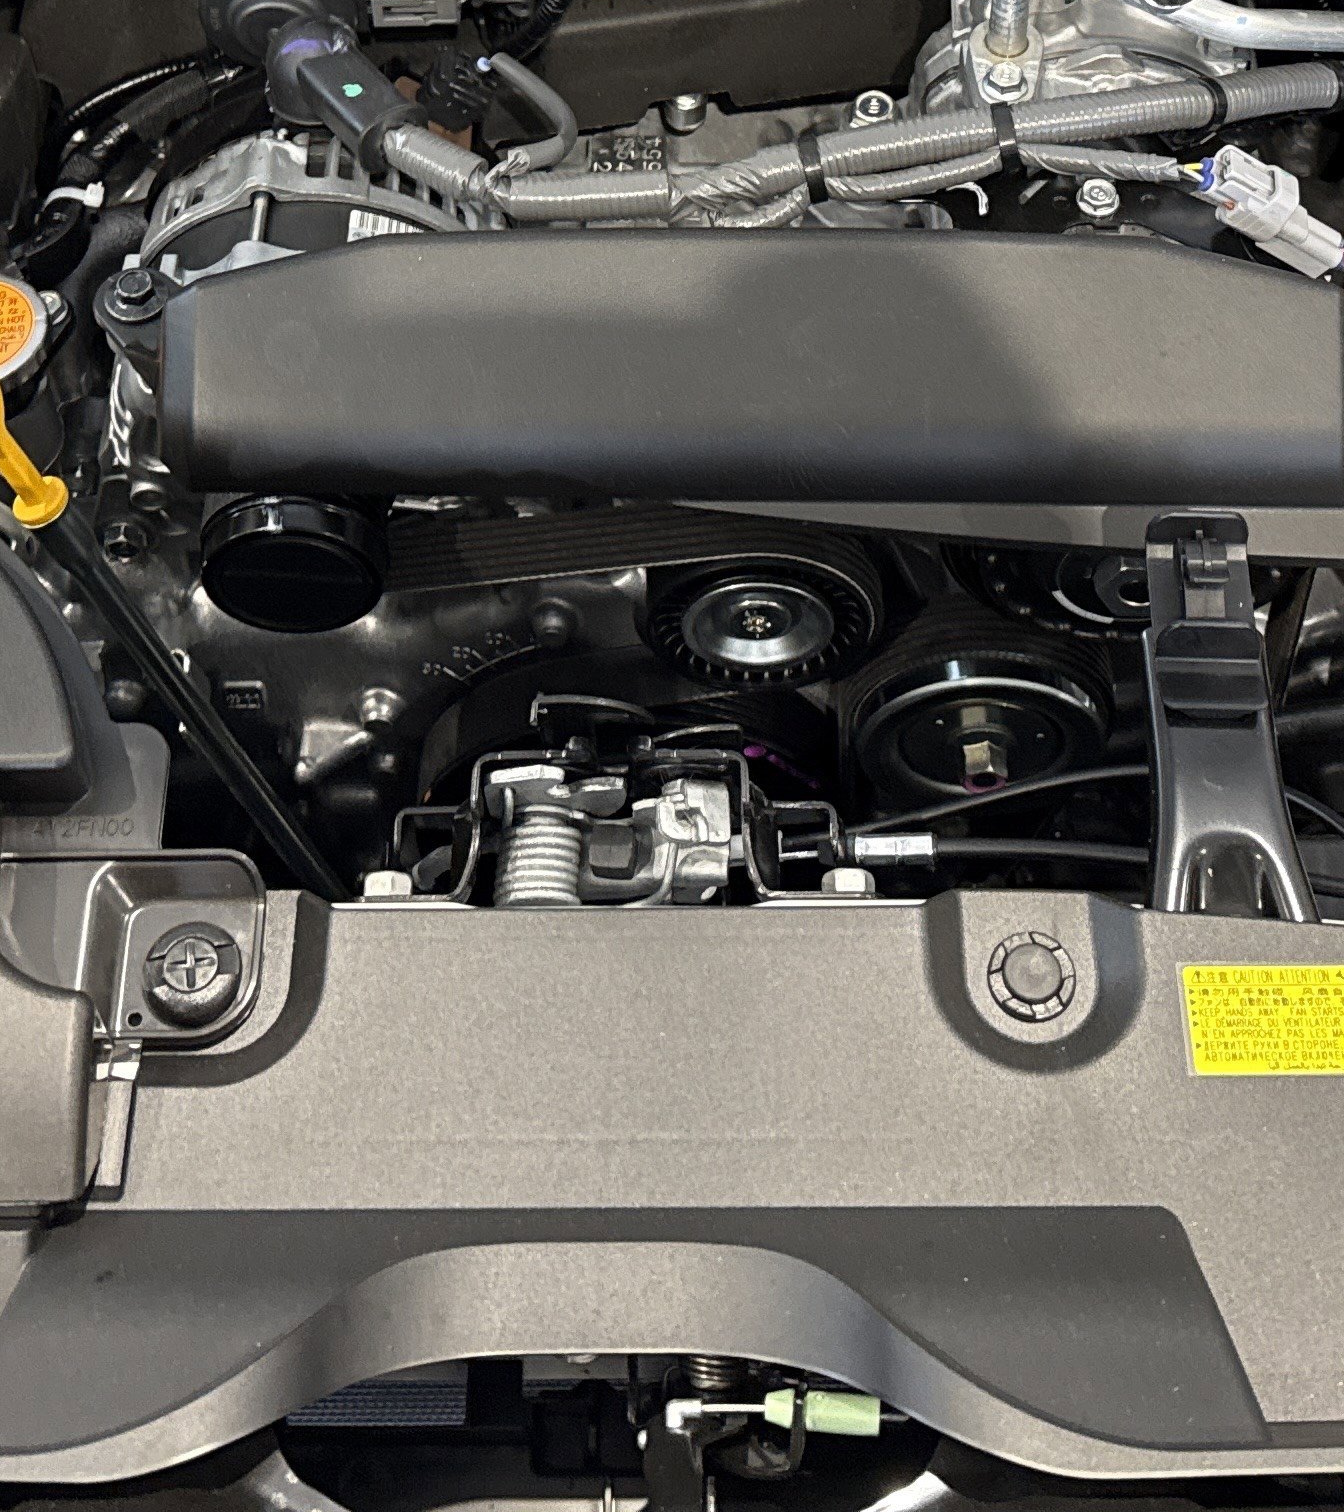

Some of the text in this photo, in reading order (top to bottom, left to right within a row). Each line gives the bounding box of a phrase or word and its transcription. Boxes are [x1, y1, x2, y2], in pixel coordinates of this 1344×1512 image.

[1233, 969, 1330, 984] CAUTION ATTENTION
[1199, 1008, 1221, 1017] KEEP
[1225, 1008, 1253, 1017] HANDS
[1289, 1007, 1307, 1017] FAN
[1311, 1007, 1344, 1017] STARTS
[1200, 1019, 1211, 1028] LE
[1267, 1018, 1279, 1028] DU
[1283, 1017, 1340, 1028] VENTILATEUR
[1230, 1028, 1281, 1039] APPROCHEZ
[1286, 1028, 1306, 1039] PAS
[1309, 1028, 1328, 1038] LES
[1252, 1040, 1280, 1050] РУКИ
[1204, 1050, 1297, 1062] АВТОМАТИЧЕСКОЕ
